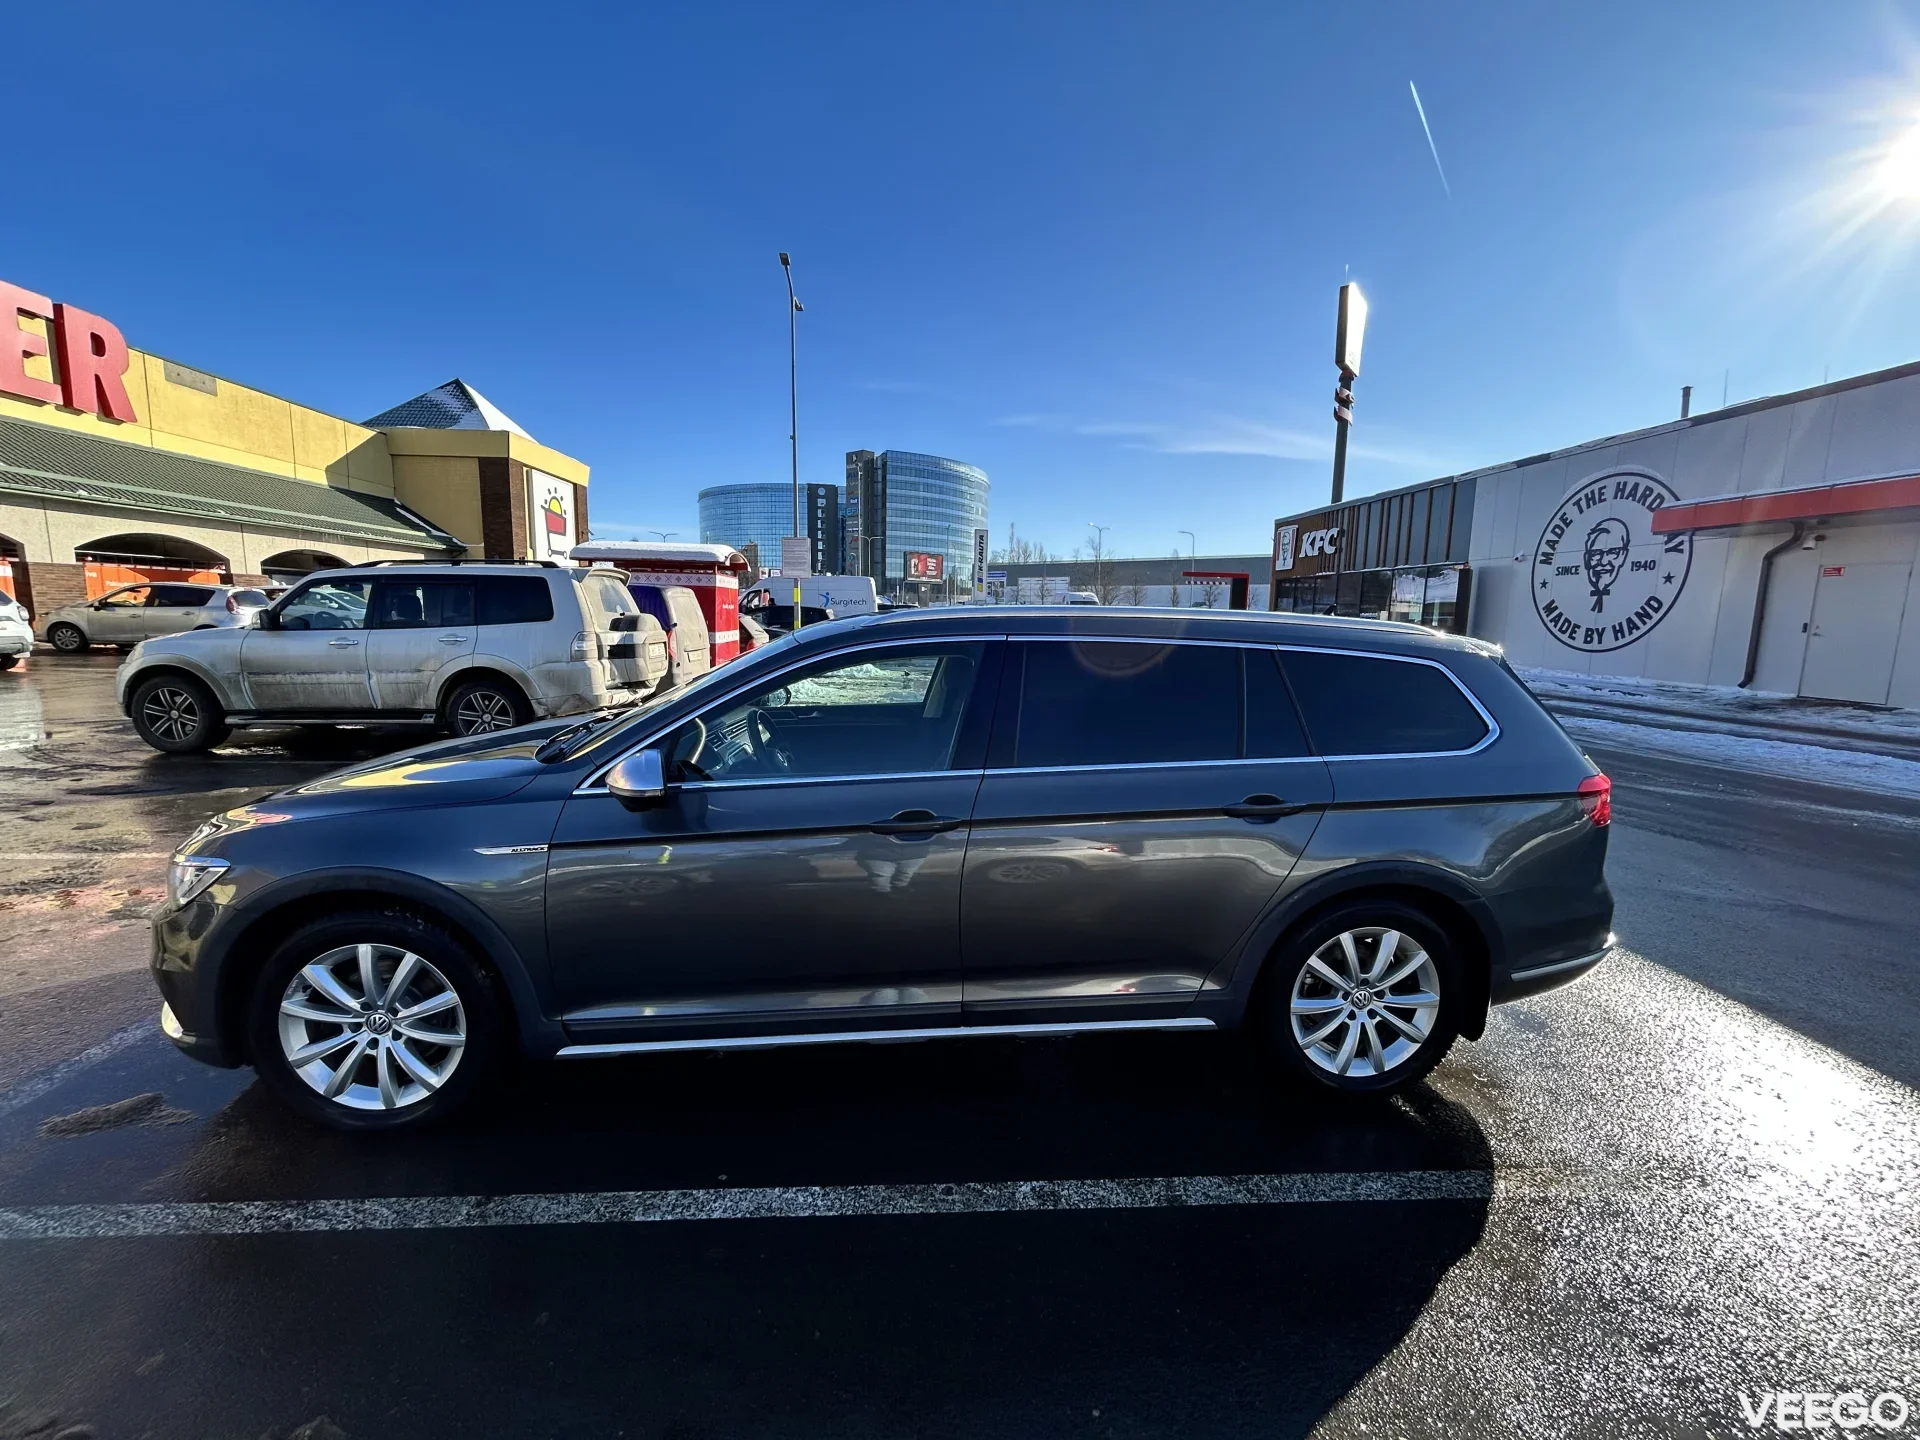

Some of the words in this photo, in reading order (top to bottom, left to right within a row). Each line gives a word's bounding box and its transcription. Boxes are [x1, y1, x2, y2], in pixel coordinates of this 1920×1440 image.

[0, 280, 137, 423] ER
[1299, 527, 1340, 557] KFC
[1539, 512, 1574, 566] MADE
[1572, 485, 1608, 515] THE
[1613, 481, 1666, 512] HARD
[1555, 564, 1581, 577] SINCE
[1630, 559, 1657, 572] 1940
[830, 597, 867, 608] Surgitech
[1542, 598, 1582, 641] MADE
[1583, 627, 1607, 645] BY
[1611, 595, 1664, 642] HAND
